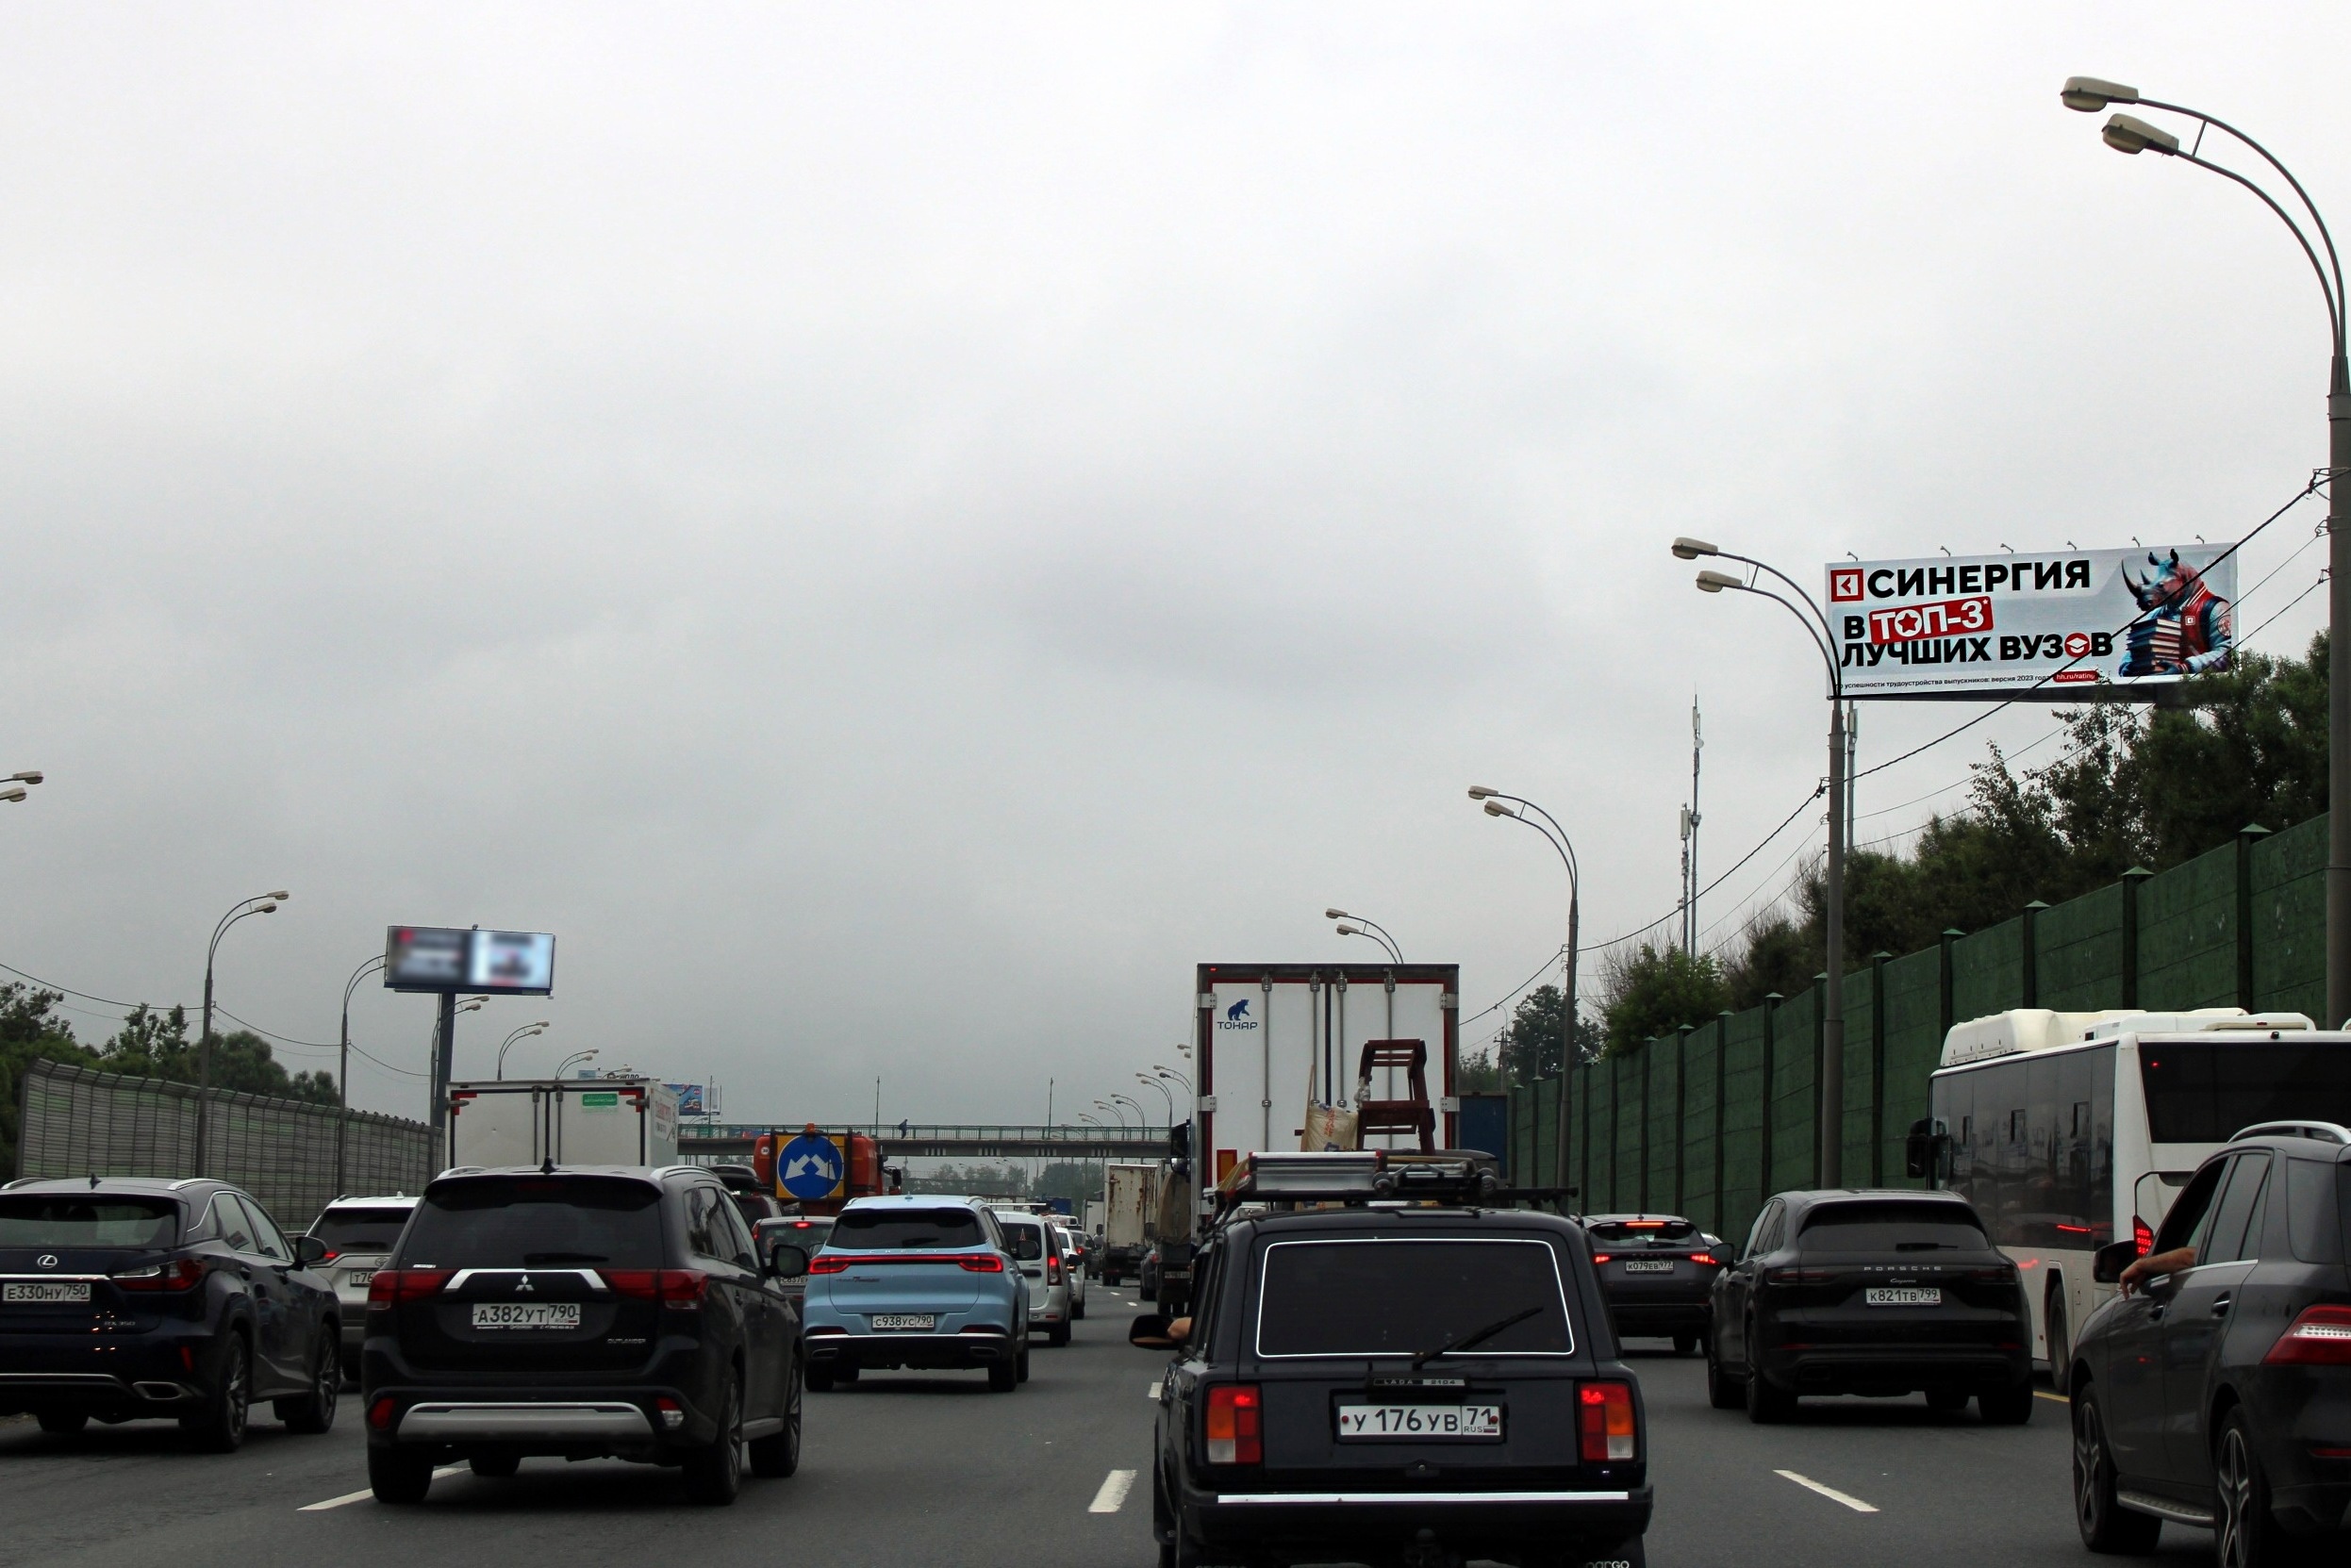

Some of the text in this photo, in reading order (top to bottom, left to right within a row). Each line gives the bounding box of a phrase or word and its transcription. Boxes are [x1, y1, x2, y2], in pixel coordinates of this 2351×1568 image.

[1867, 559, 2090, 599] СИНЕРГИЯ
[1844, 615, 1865, 640] В
[1842, 632, 2113, 668] ЛУЧШИХ ВУЗОВ
[1886, 679, 1943, 687] трудоустройства
[1217, 1021, 1258, 1030] ТОНАР
[65, 1284, 87, 1296] 750
[1919, 1289, 1937, 1298] 799
[550, 1305, 576, 1318] 790
[916, 1315, 932, 1324] 790
[1466, 1408, 1492, 1426] 71
